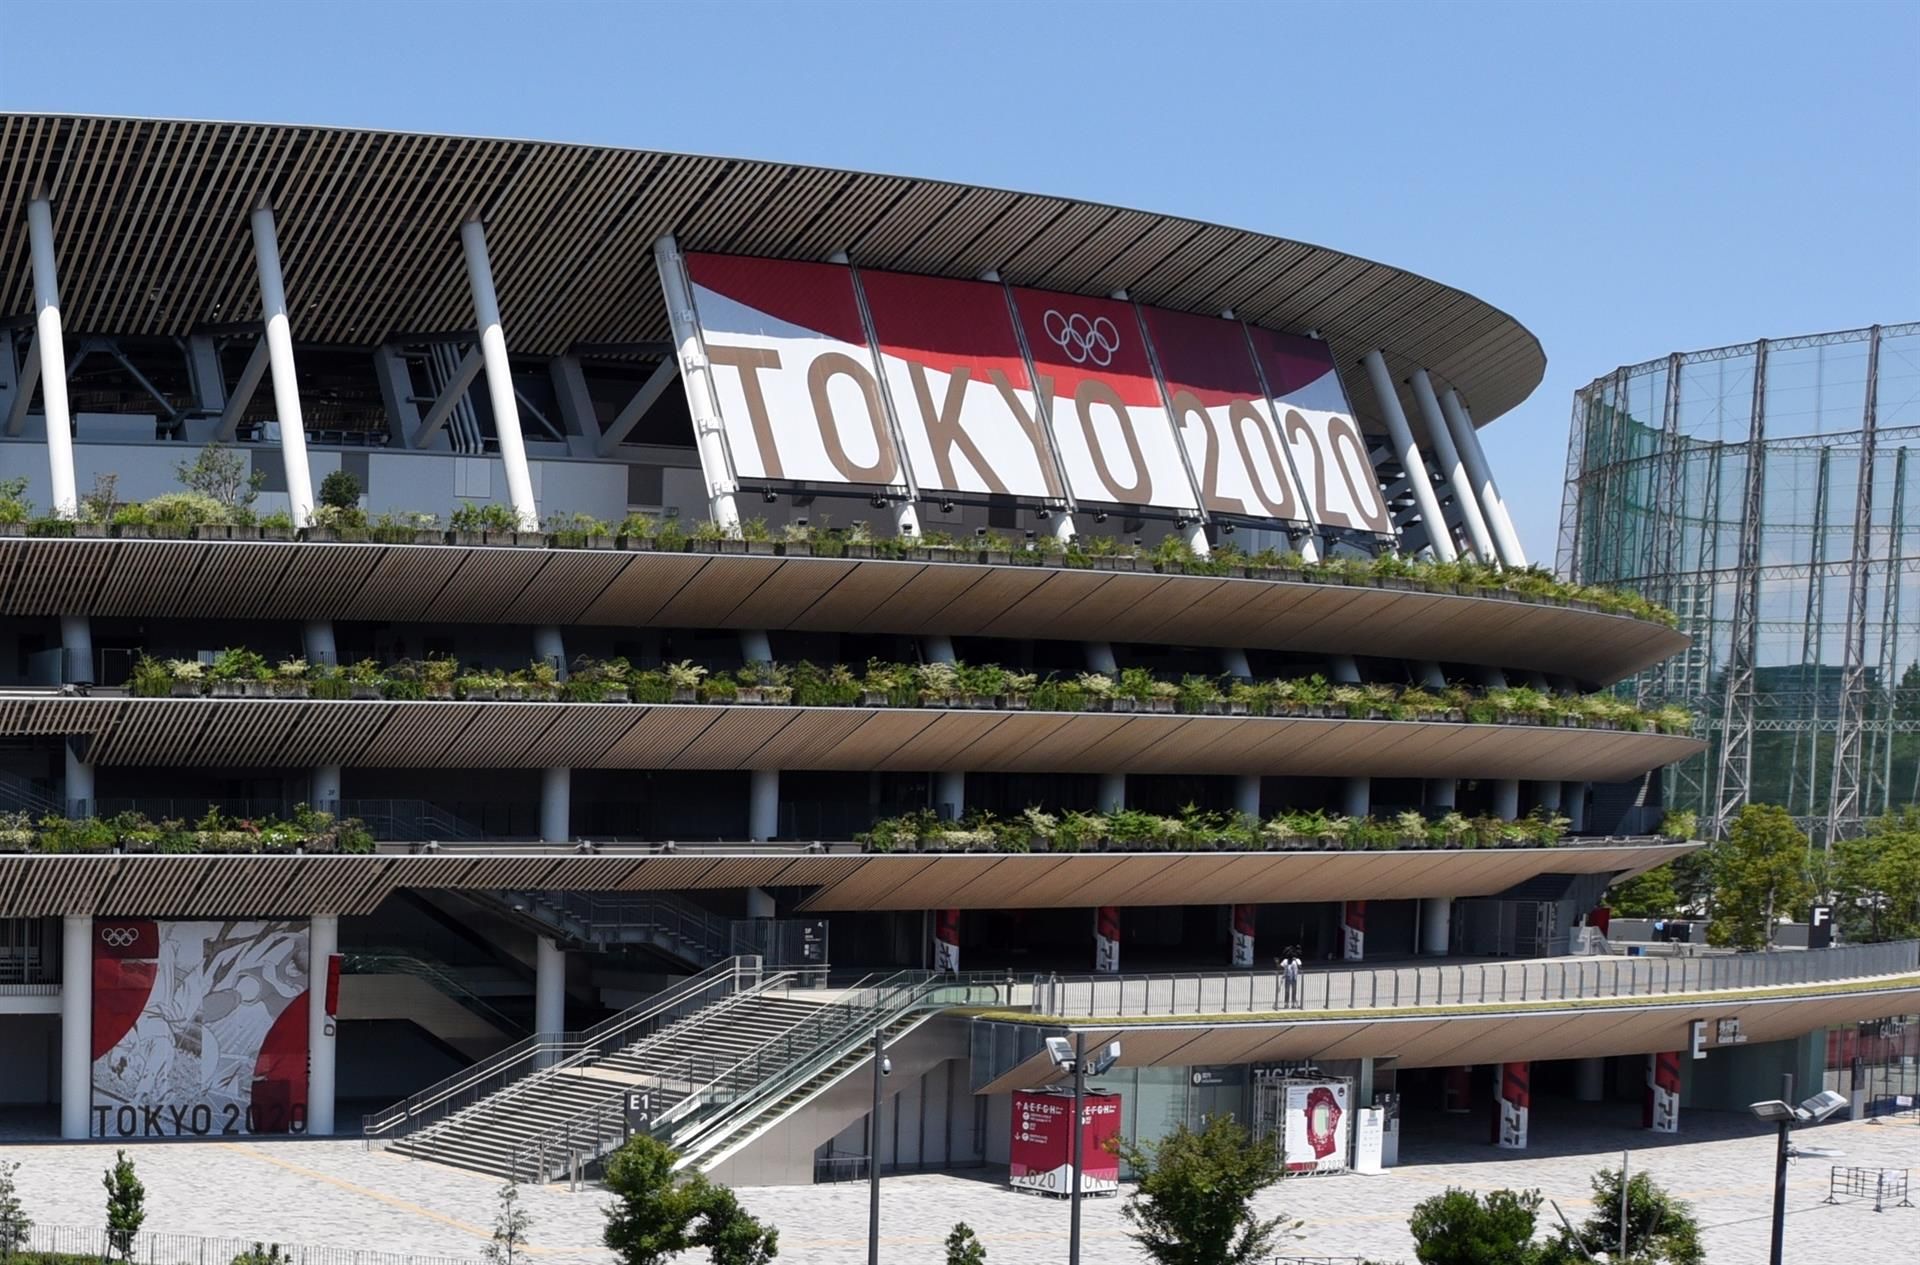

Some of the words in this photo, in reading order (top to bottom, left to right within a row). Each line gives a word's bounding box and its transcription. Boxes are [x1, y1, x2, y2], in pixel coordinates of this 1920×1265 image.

[704, 344, 1152, 504] TOKYO
[1174, 390, 1389, 532] 2020
[1813, 907, 1831, 926] F
[1693, 1021, 1708, 1060] E
[630, 1094, 649, 1110] E1
[93, 1104, 211, 1137] TOKYO
[222, 1103, 308, 1136] 2020
[1019, 1168, 1056, 1189] 2020
